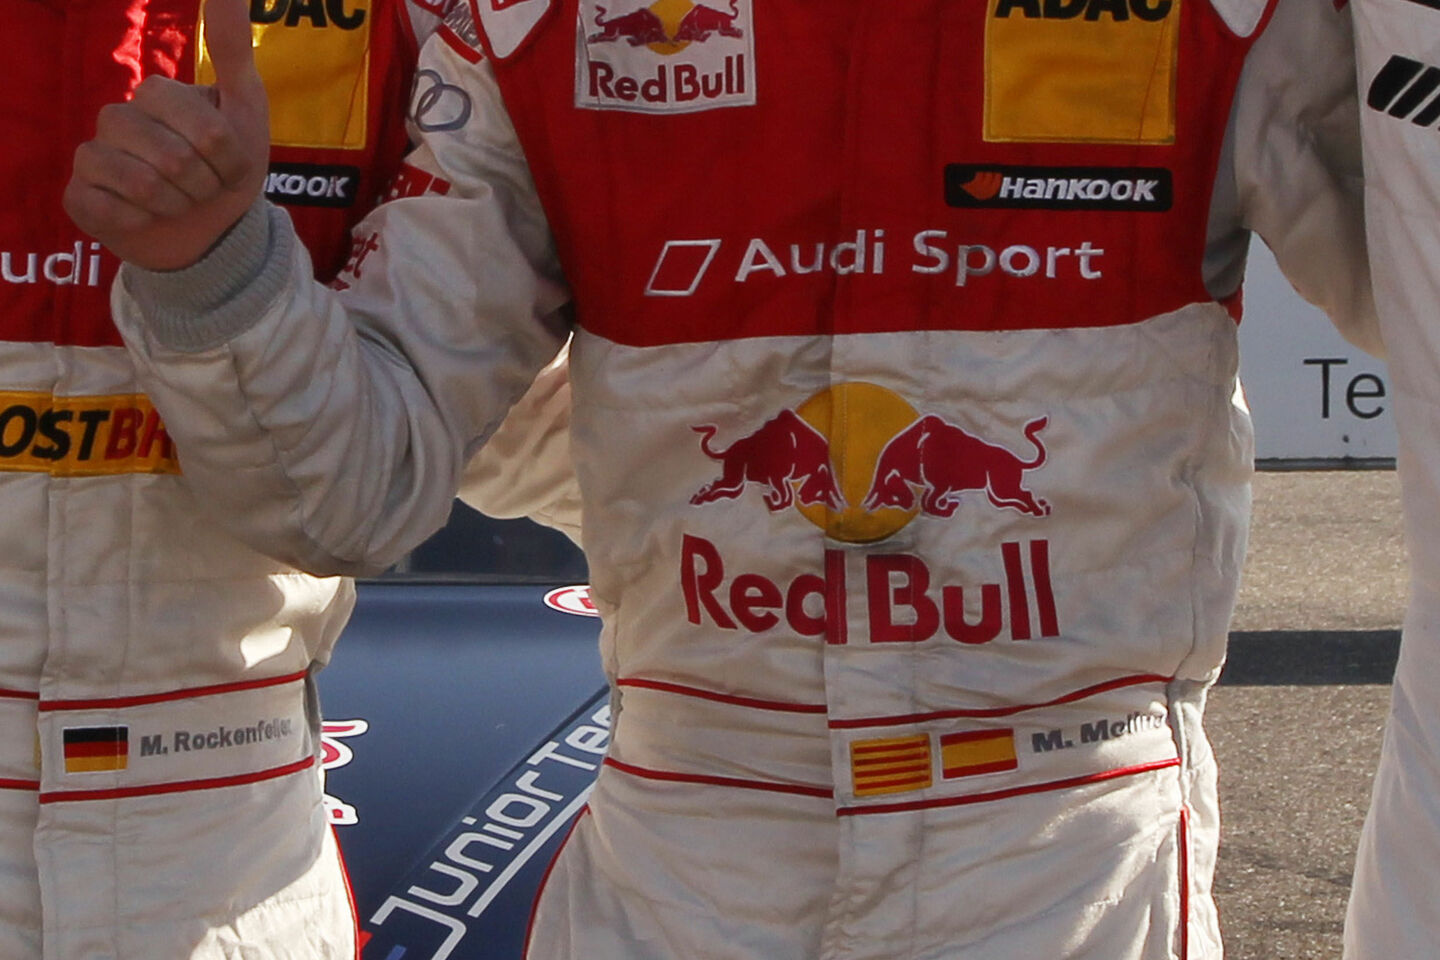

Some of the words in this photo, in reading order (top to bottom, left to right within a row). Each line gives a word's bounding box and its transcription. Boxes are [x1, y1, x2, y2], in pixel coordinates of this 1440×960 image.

[588, 61, 667, 103] Red
[673, 54, 745, 102] Bull
[734, 228, 885, 282] Audi
[912, 229, 1104, 287] Sport
[1303, 358, 1386, 420] Te
[680, 533, 848, 645] Red
[866, 539, 1060, 645] Bull
[140, 734, 168, 757] M.
[1031, 729, 1073, 753] M.
